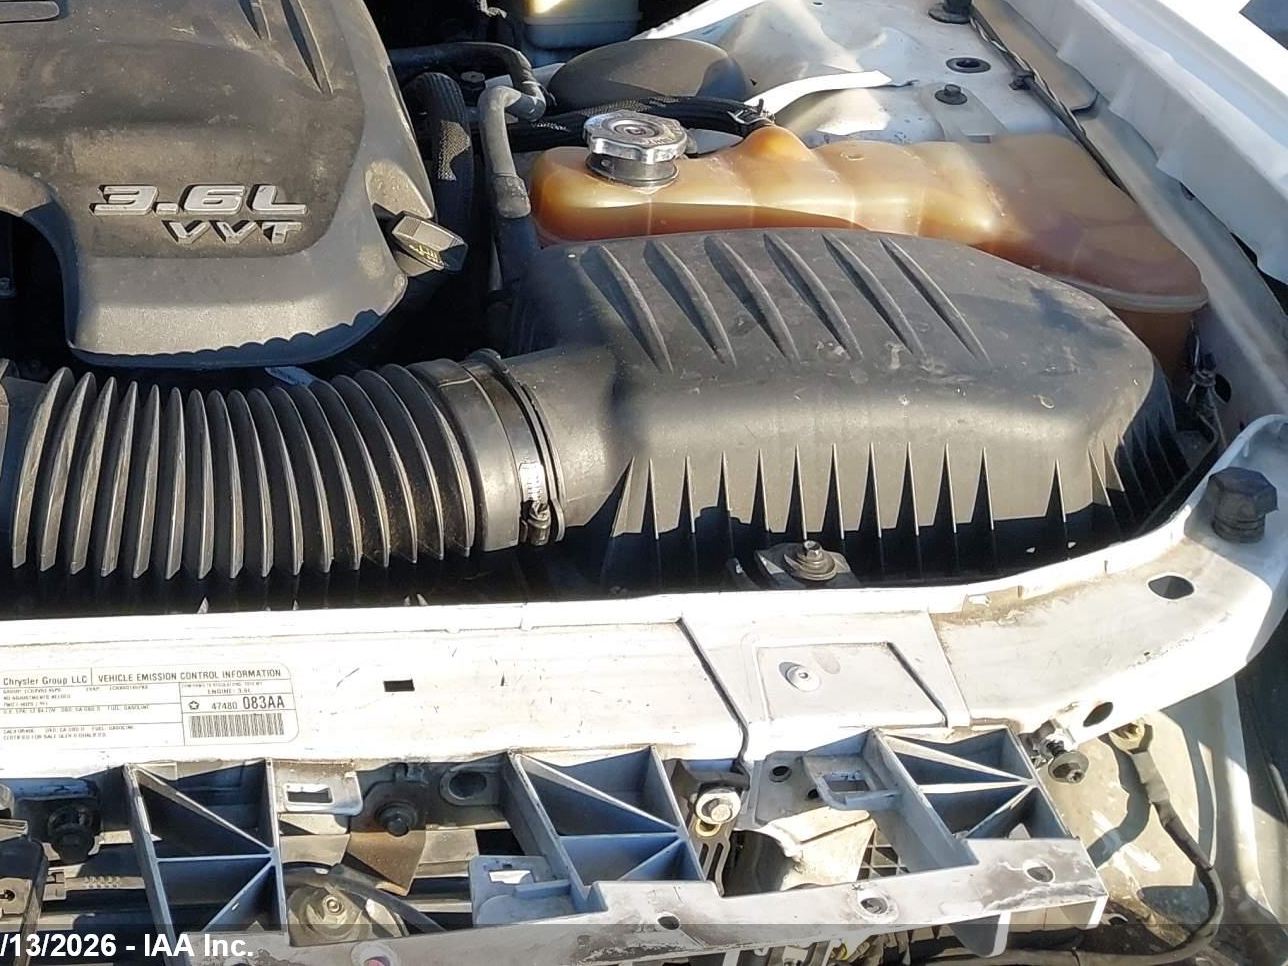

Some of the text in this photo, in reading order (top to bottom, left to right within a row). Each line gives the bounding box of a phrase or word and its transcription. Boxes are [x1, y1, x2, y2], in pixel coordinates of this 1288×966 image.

[90, 184, 309, 216] 3.6L
[162, 220, 303, 245] VVT
[3, 675, 88, 687] Chrysler Group LLC
[98, 669, 281, 683] VEHICLE EMISSION CONTROL INFORMATION
[211, 695, 285, 710] 47480 083AA
